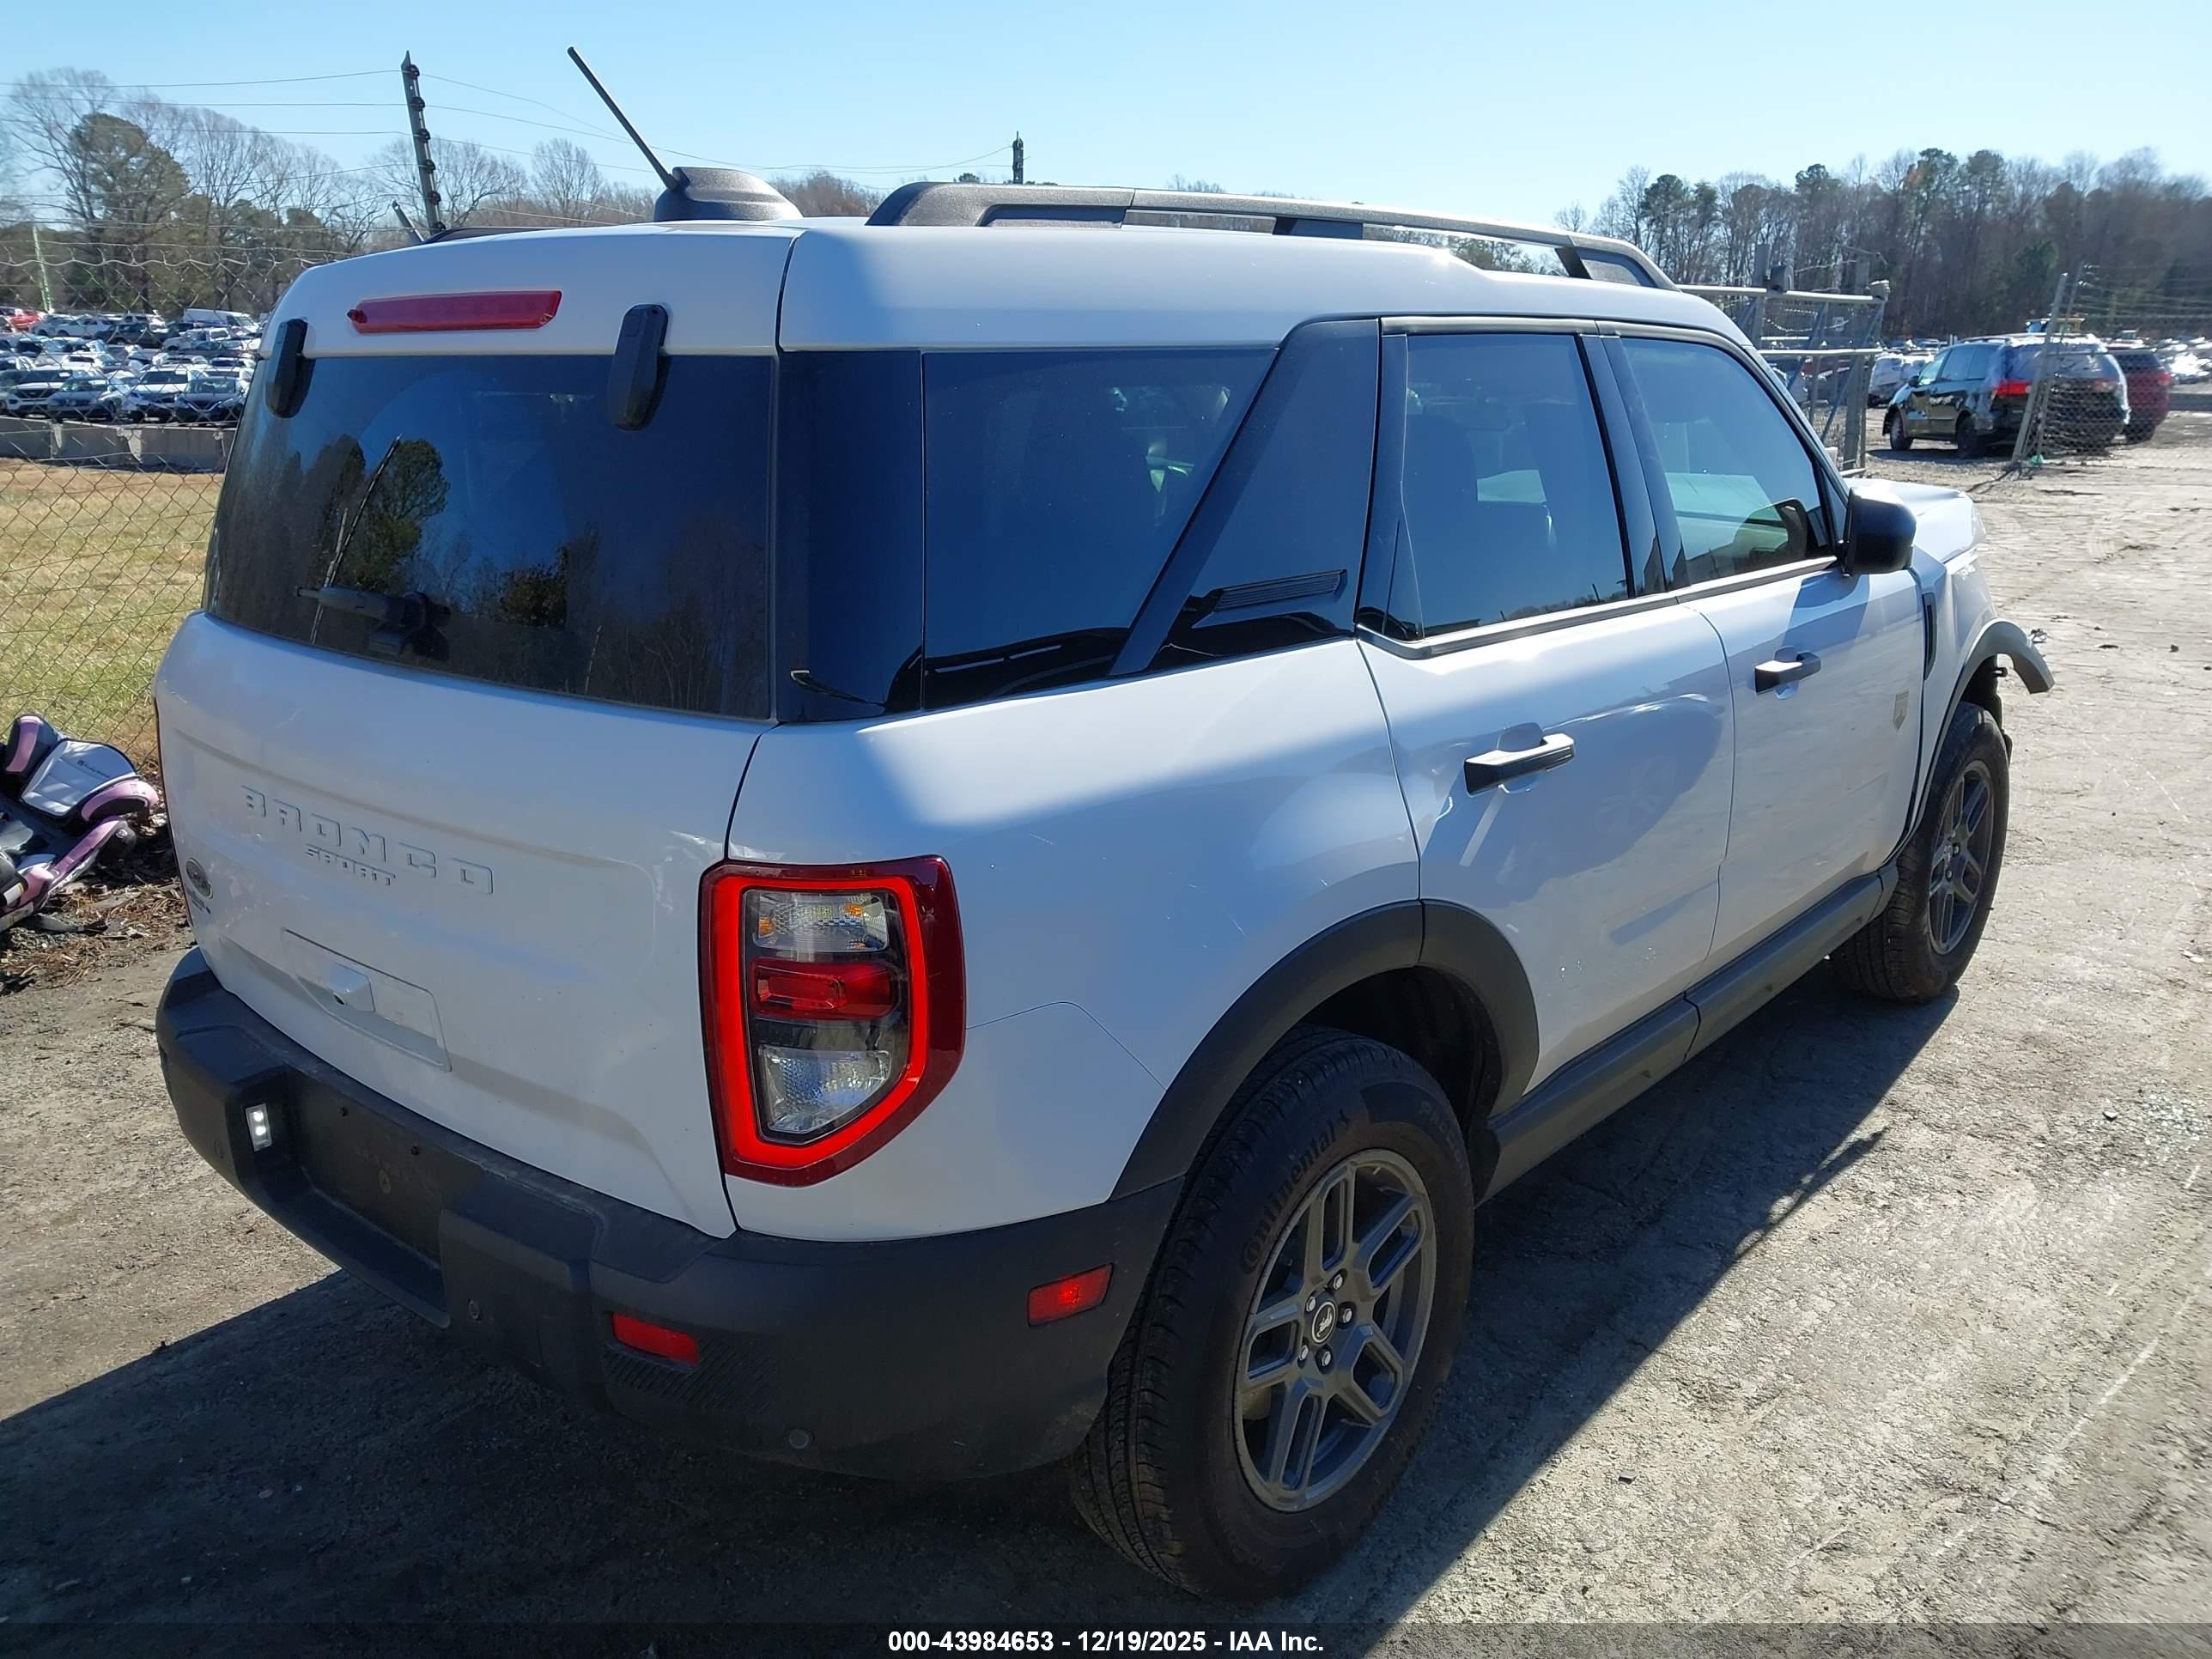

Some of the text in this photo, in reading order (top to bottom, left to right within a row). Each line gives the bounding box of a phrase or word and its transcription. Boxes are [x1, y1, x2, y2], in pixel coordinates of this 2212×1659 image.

[240, 785, 494, 895] BRONCO
[304, 842, 396, 886] SPORT
[1239, 1121, 1337, 1275] Continental
